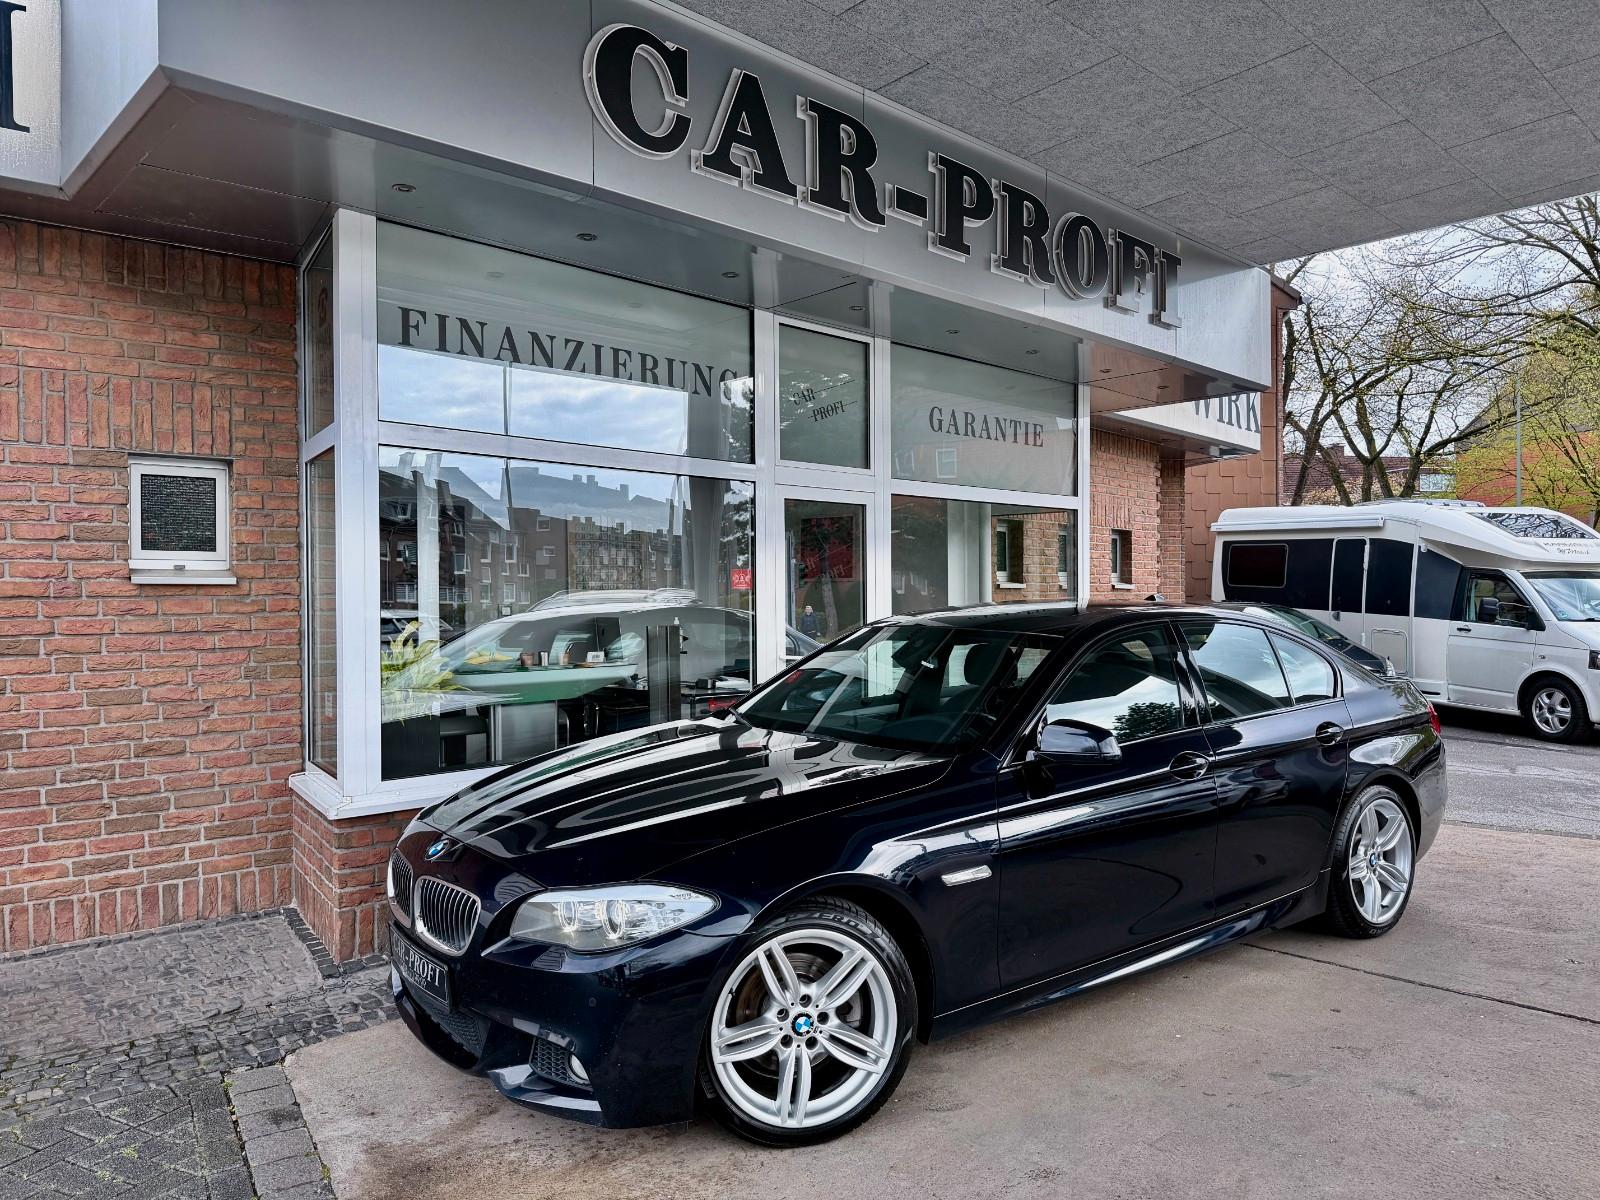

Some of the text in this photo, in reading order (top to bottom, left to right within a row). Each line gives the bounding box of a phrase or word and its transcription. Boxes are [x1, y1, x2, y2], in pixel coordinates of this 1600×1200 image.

[583, 23, 1182, 330] CAR-PROFI
[792, 388, 816, 406] CAR
[811, 400, 846, 422] PROFI
[928, 406, 1044, 448] GARANTIE
